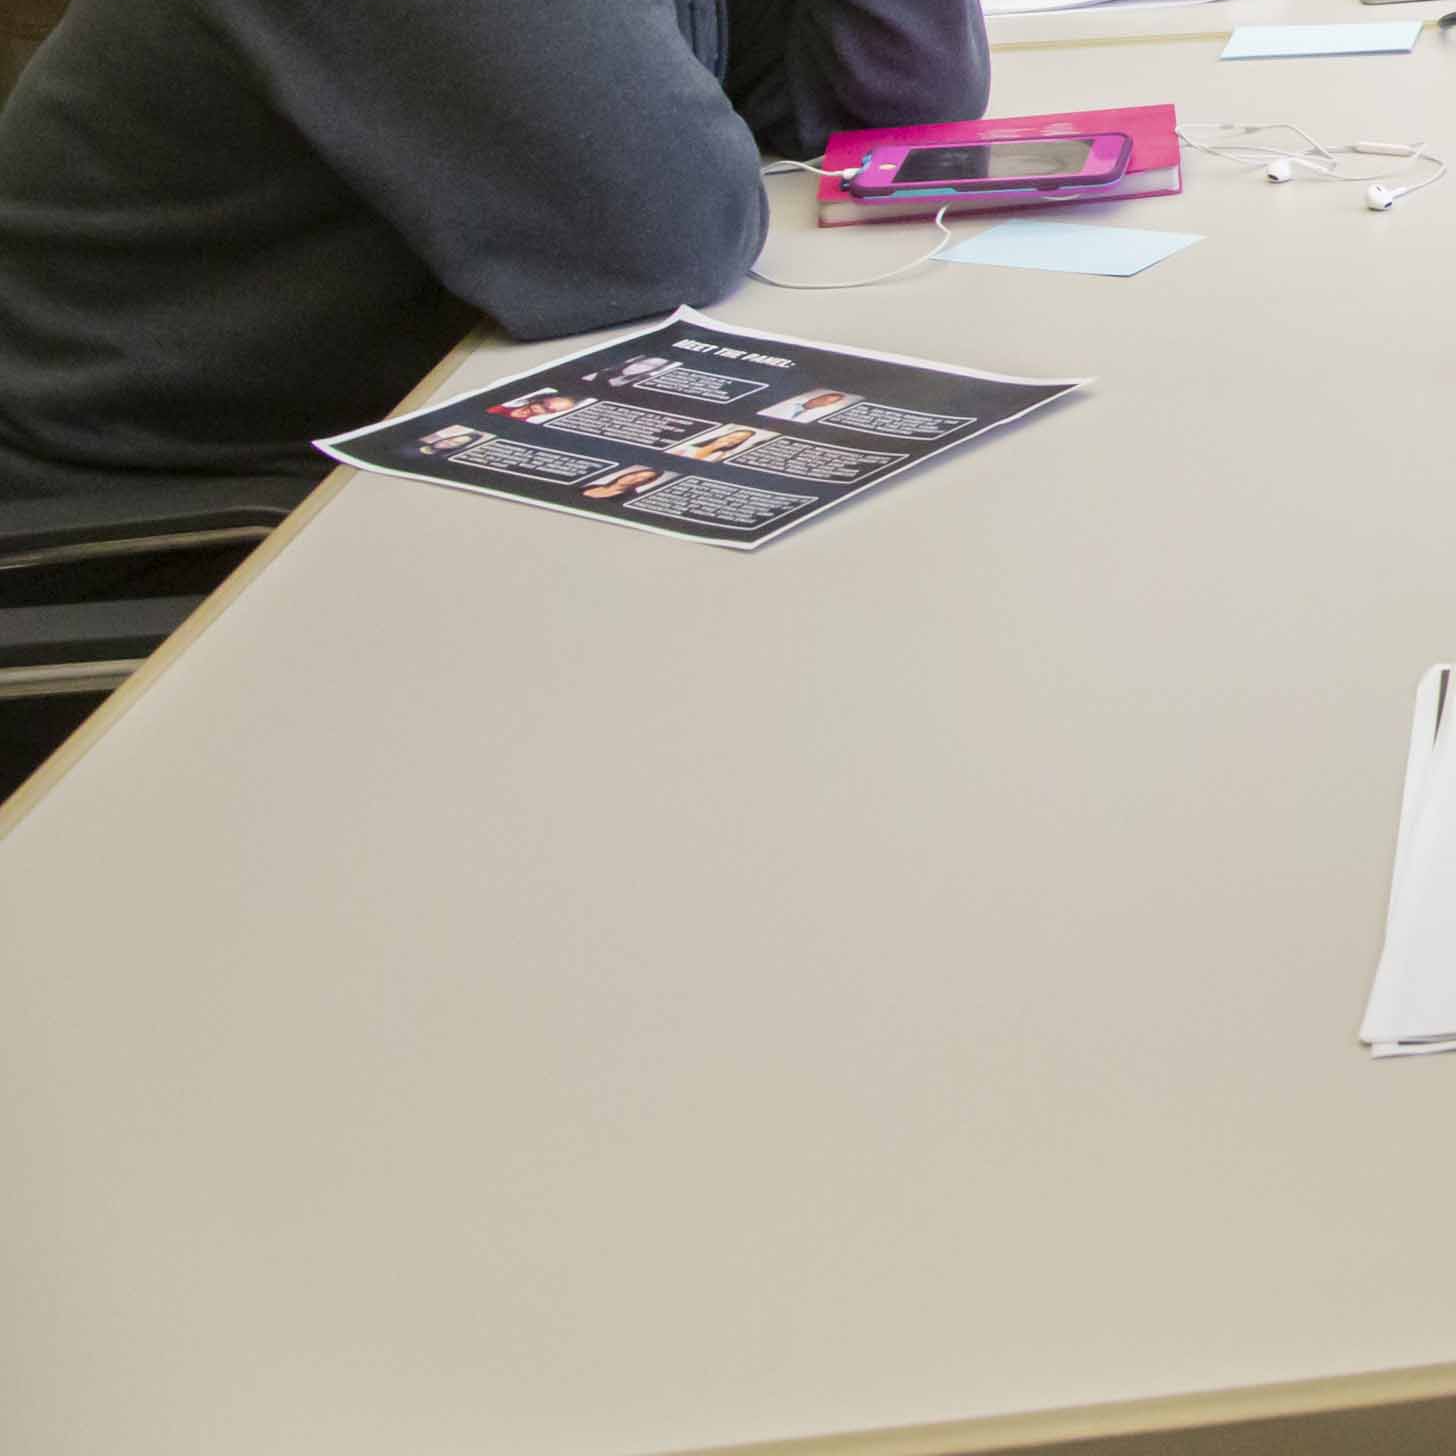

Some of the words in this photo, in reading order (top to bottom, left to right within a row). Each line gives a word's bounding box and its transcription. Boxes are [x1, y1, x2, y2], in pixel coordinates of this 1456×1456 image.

[671, 339, 719, 353] MEET
[713, 347, 748, 359] THE
[741, 353, 797, 368] PANEL:
